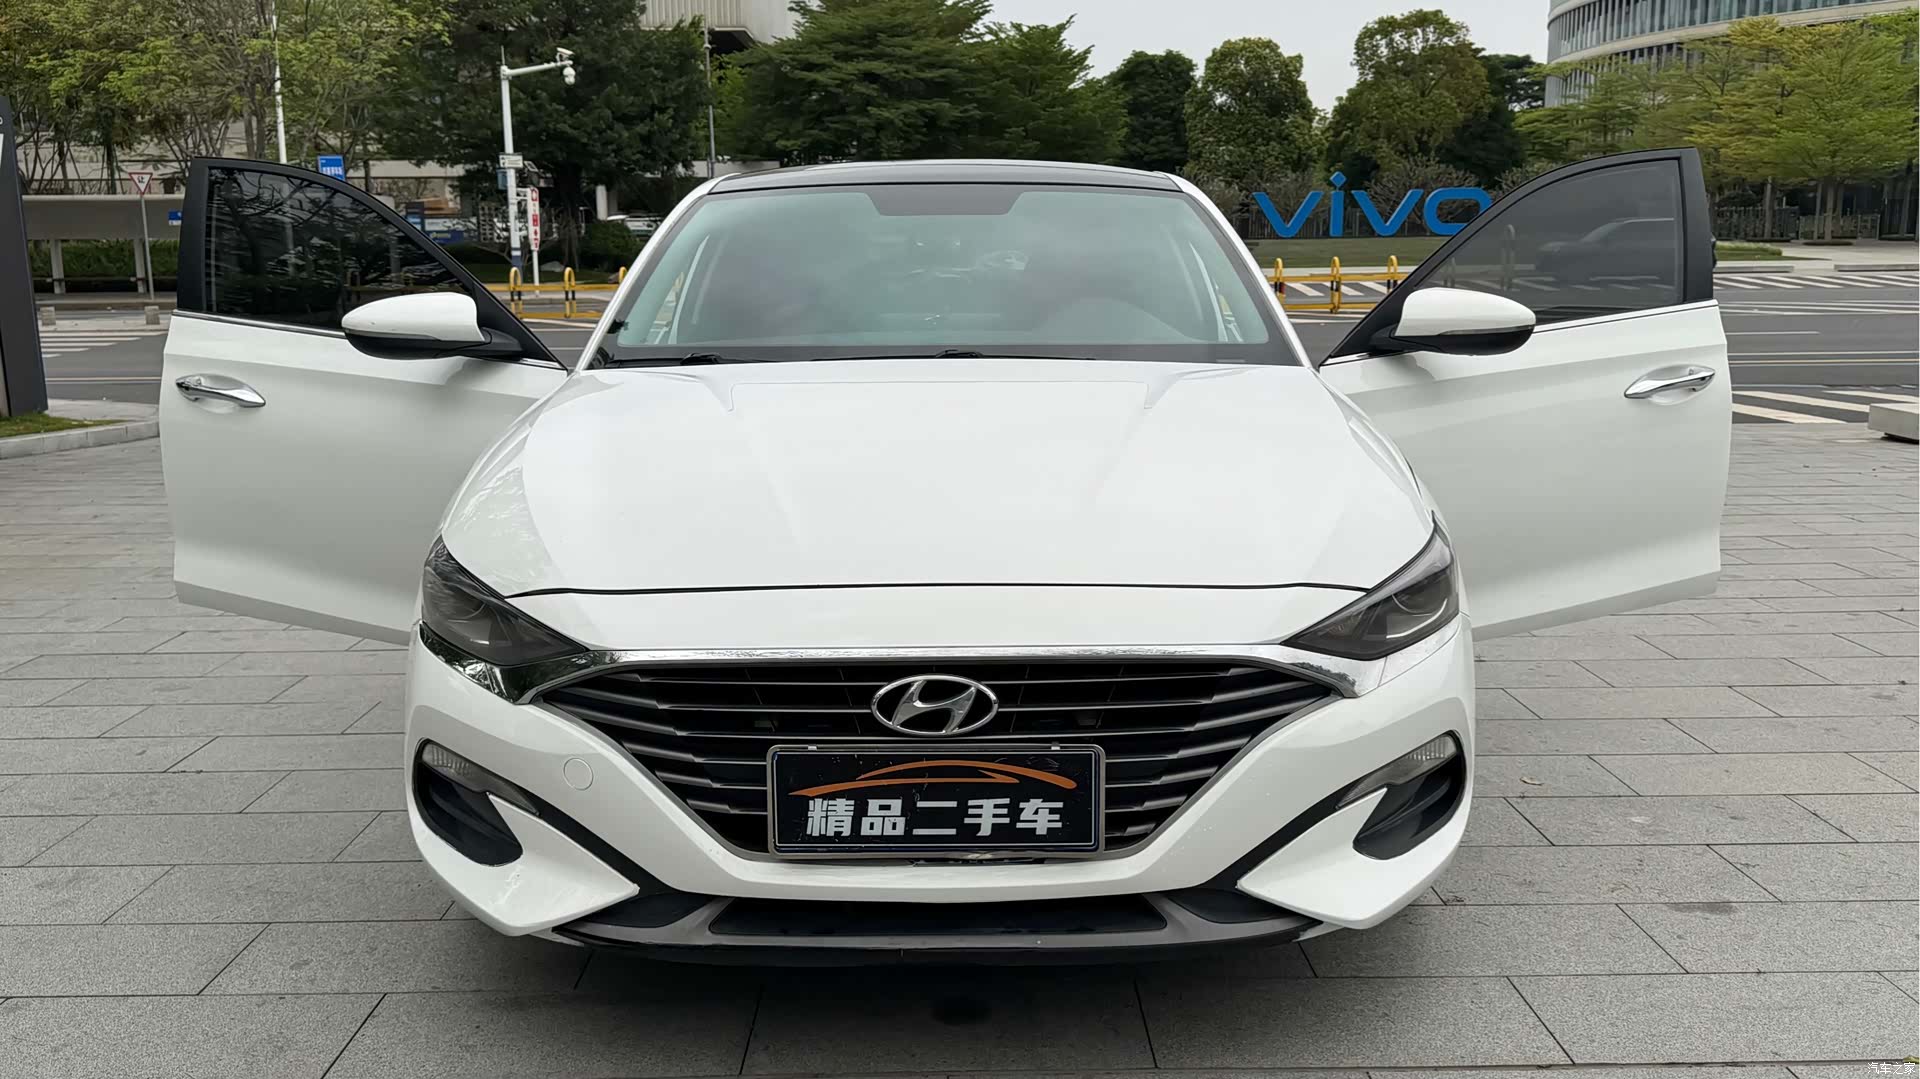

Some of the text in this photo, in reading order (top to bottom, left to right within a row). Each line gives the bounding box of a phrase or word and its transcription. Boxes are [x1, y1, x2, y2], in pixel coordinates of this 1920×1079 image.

[1254, 171, 1493, 237] vivo
[806, 797, 1064, 837] 精品二手车
